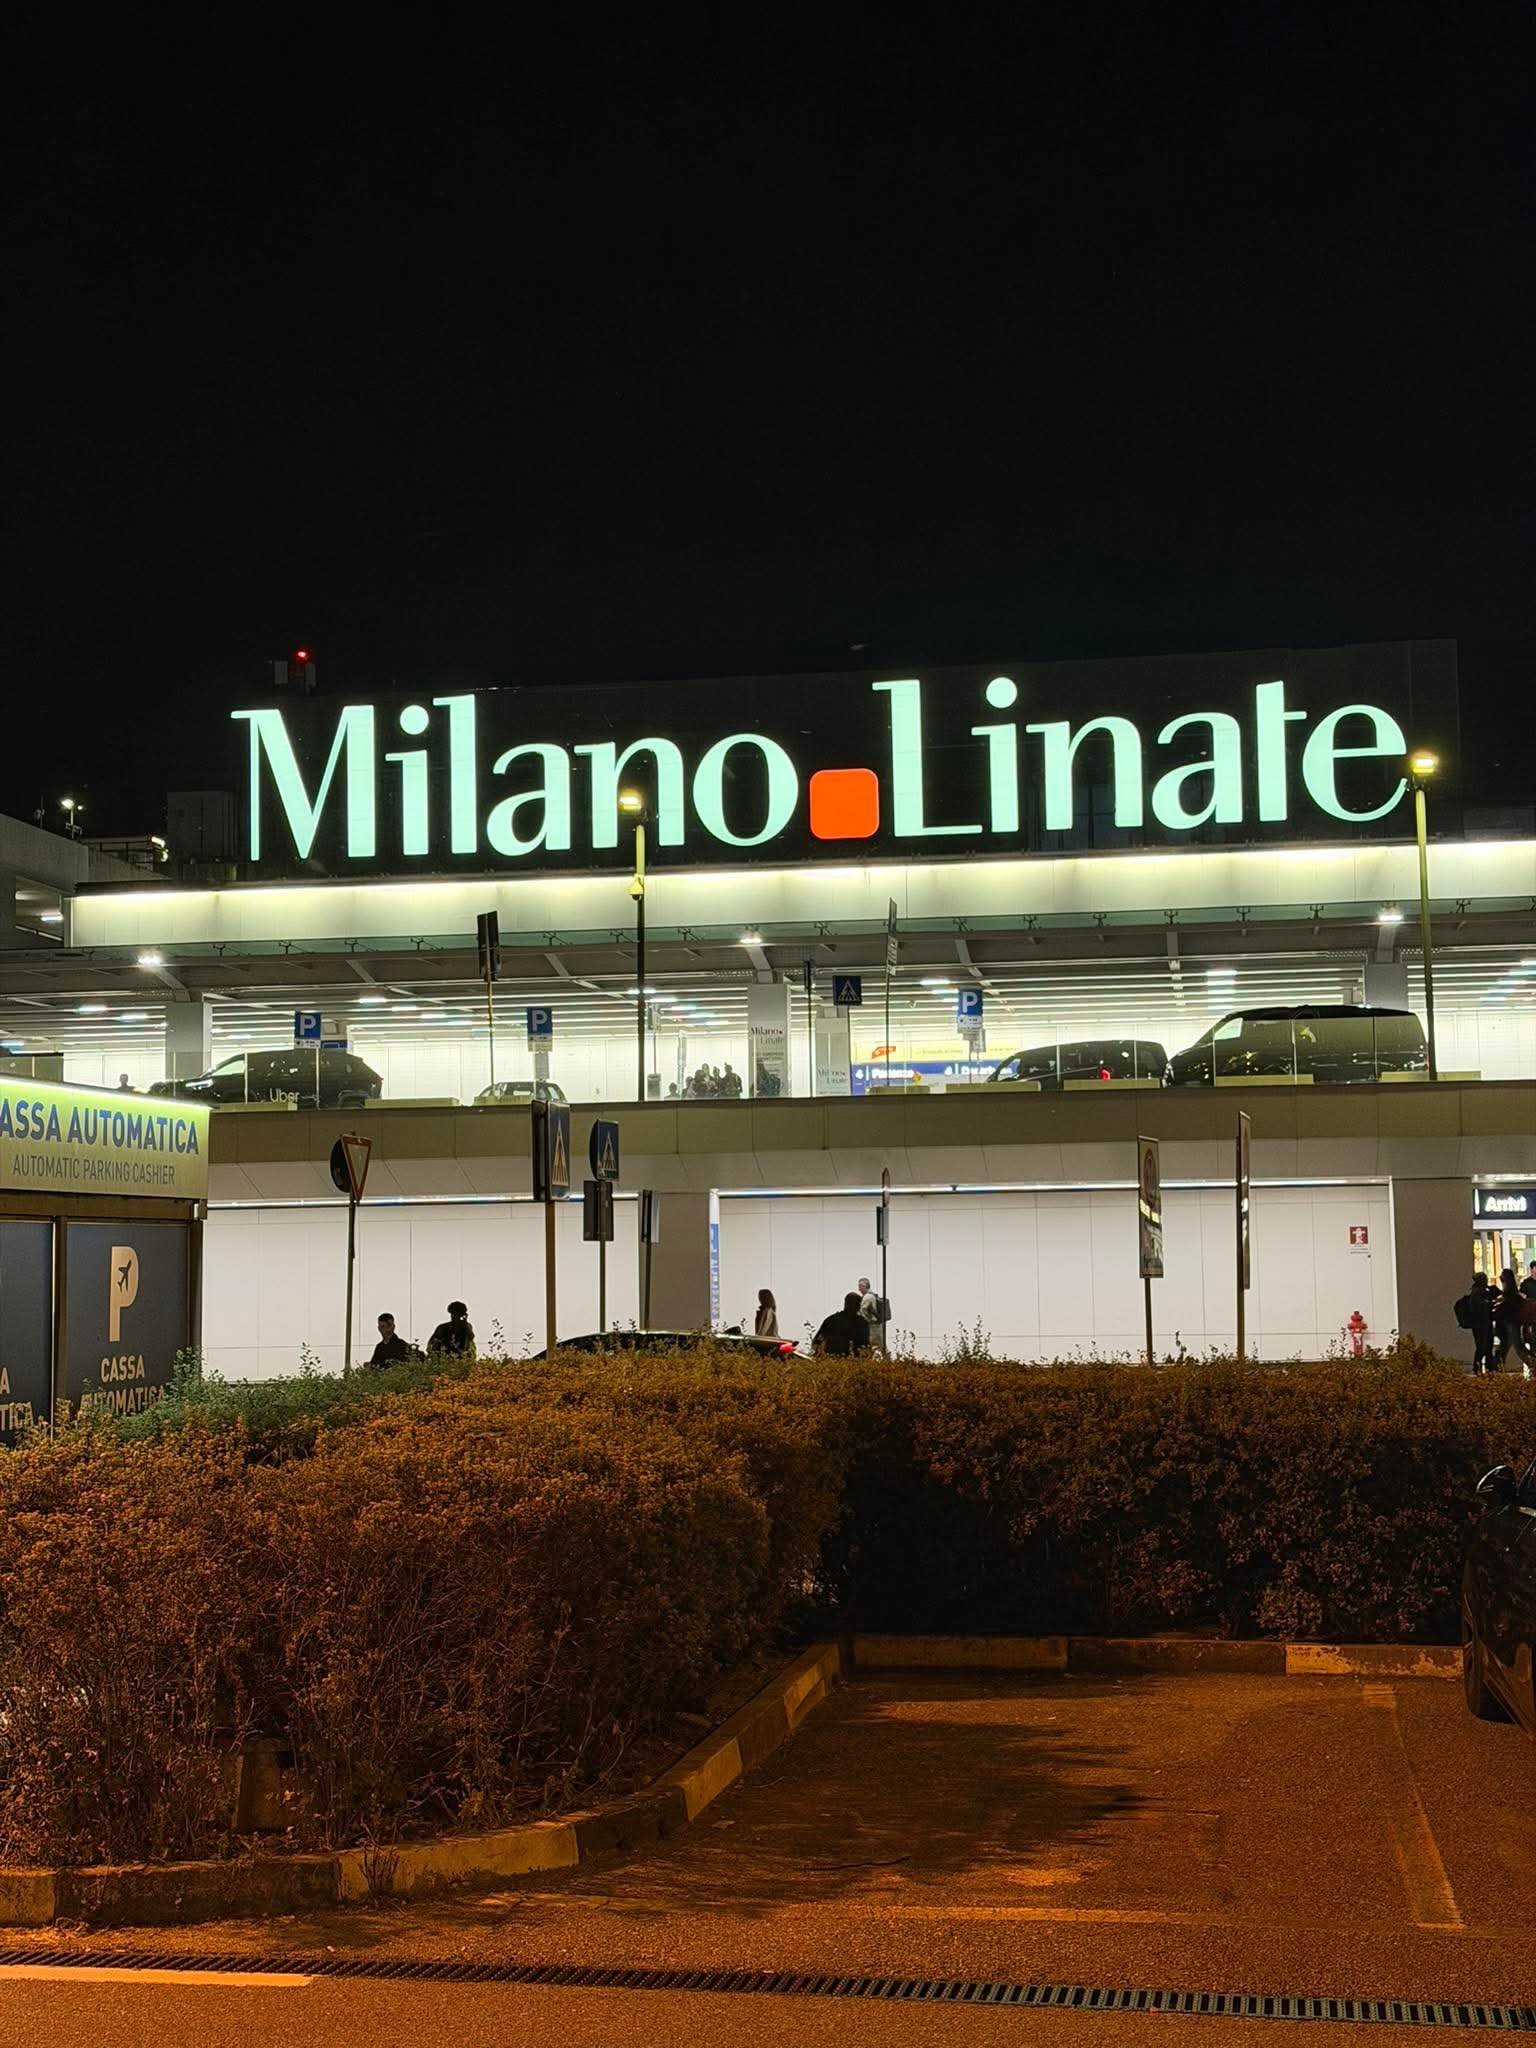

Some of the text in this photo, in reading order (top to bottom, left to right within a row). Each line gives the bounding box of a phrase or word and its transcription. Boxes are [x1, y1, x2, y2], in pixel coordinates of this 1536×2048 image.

[231, 677, 1409, 861] Milano Linate
[962, 991, 978, 1013] P
[299, 1014, 317, 1036] P
[531, 1009, 548, 1032] P
[269, 1087, 301, 1103] Uber
[67, 1105, 200, 1156] AUTOMATICA
[12, 1154, 175, 1185] AUTOMATIC PARKING CASHIER
[101, 1354, 146, 1383] CASSA
